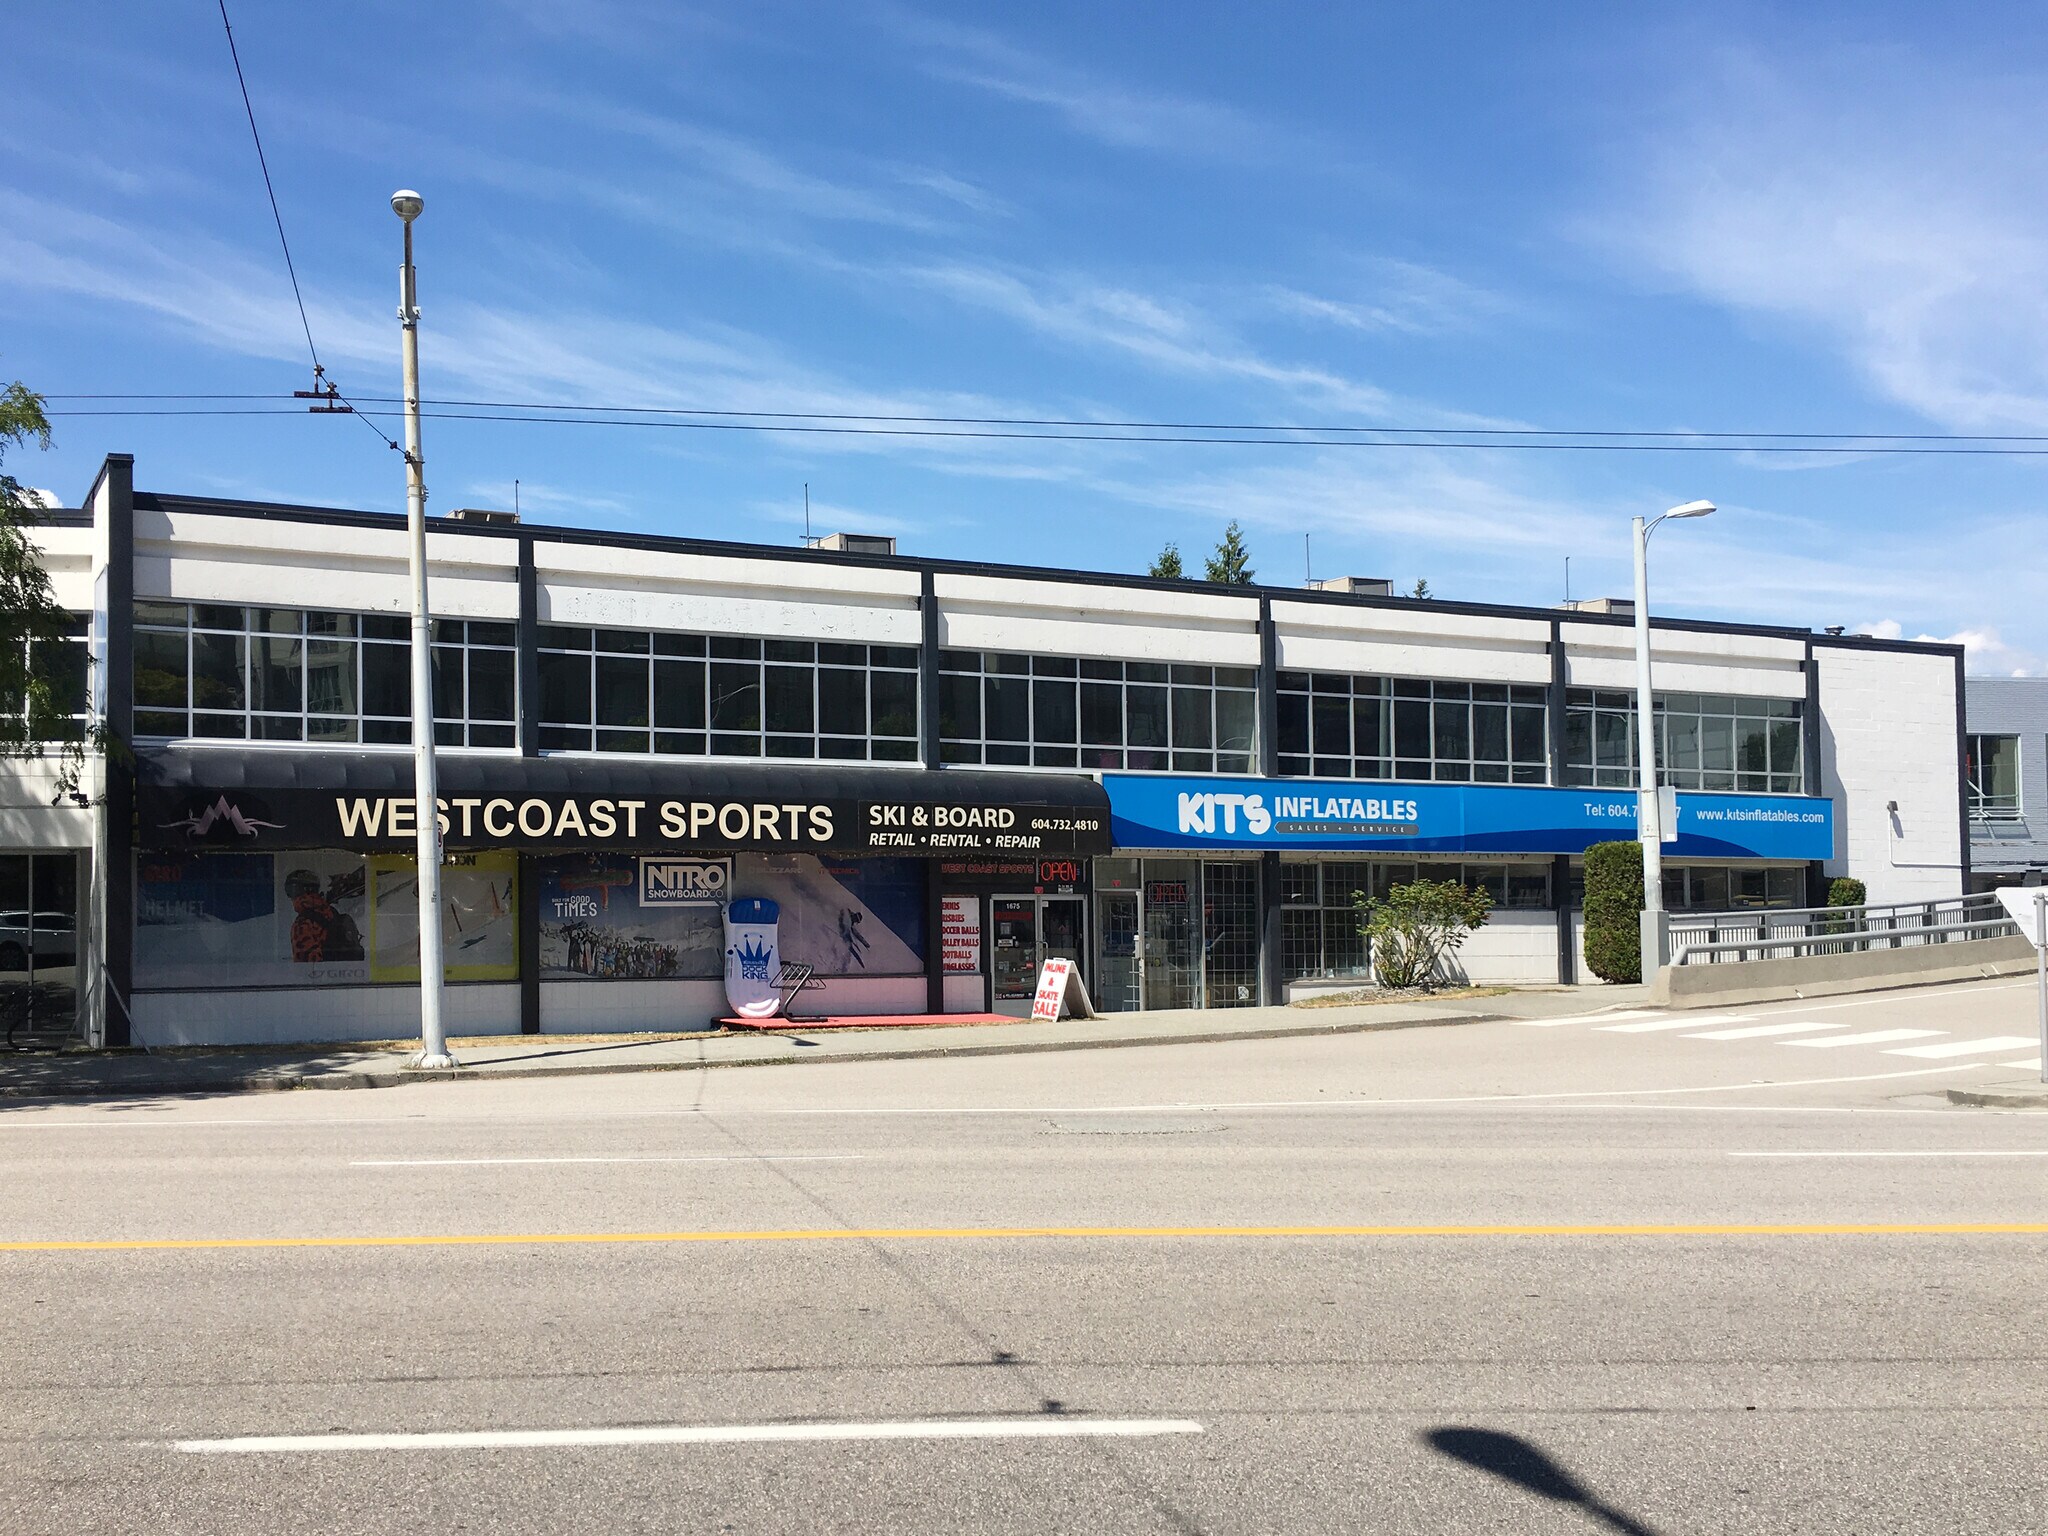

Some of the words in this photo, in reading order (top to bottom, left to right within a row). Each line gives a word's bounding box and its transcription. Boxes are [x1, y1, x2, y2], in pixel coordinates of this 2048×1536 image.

[660, 801, 834, 841] SPORTS
[870, 805, 905, 826] SKI
[912, 806, 929, 826] &
[934, 807, 1015, 828] BOARD
[1178, 793, 1272, 835] KITS
[1275, 797, 1418, 821] INFLATABLES
[1584, 804, 1605, 817] Tel:
[1696, 808, 1824, 824] www.kitsinflatables.com
[1031, 819, 1098, 831] 604.732.4810
[1289, 824, 1327, 832] SALES
[1353, 825, 1404, 833] SERVICE
[869, 833, 916, 846] RETAIL
[930, 834, 981, 847] RENTAL
[995, 835, 1041, 849] REPAIR
[648, 865, 726, 890] NITRO
[1041, 862, 1076, 881] OPEN
[570, 895, 591, 904] GOOD
[942, 926, 960, 934] OCCER
[961, 926, 979, 934] BALLS
[942, 938, 960, 946] OLLEY
[961, 938, 979, 947] BALLS
[327, 969, 365, 978] GIRO
[1045, 962, 1067, 974] INLINE
[1038, 989, 1059, 1001] SKATE
[1034, 1000, 1059, 1017] SALE
